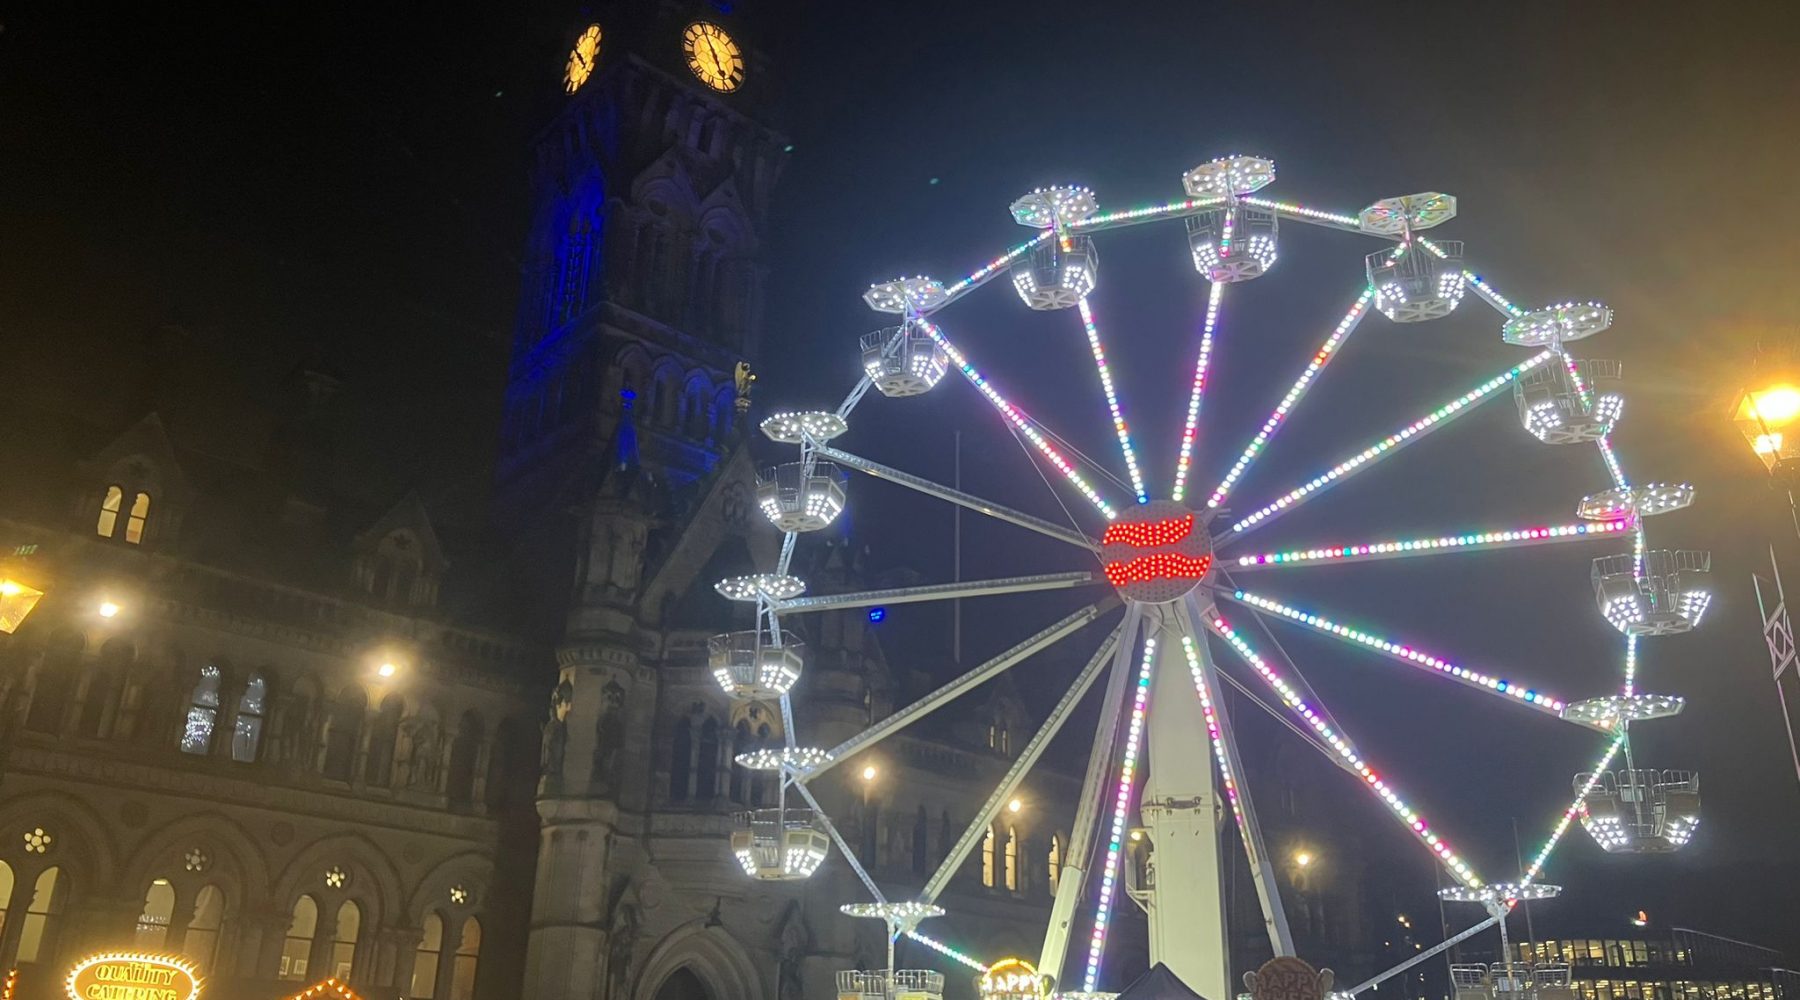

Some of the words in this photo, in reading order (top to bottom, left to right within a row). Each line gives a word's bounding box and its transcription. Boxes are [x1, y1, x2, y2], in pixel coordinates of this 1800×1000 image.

[95, 964, 178, 985] QUALITY
[980, 973, 1043, 993] HAPPY
[1252, 972, 1321, 993] HAPPY
